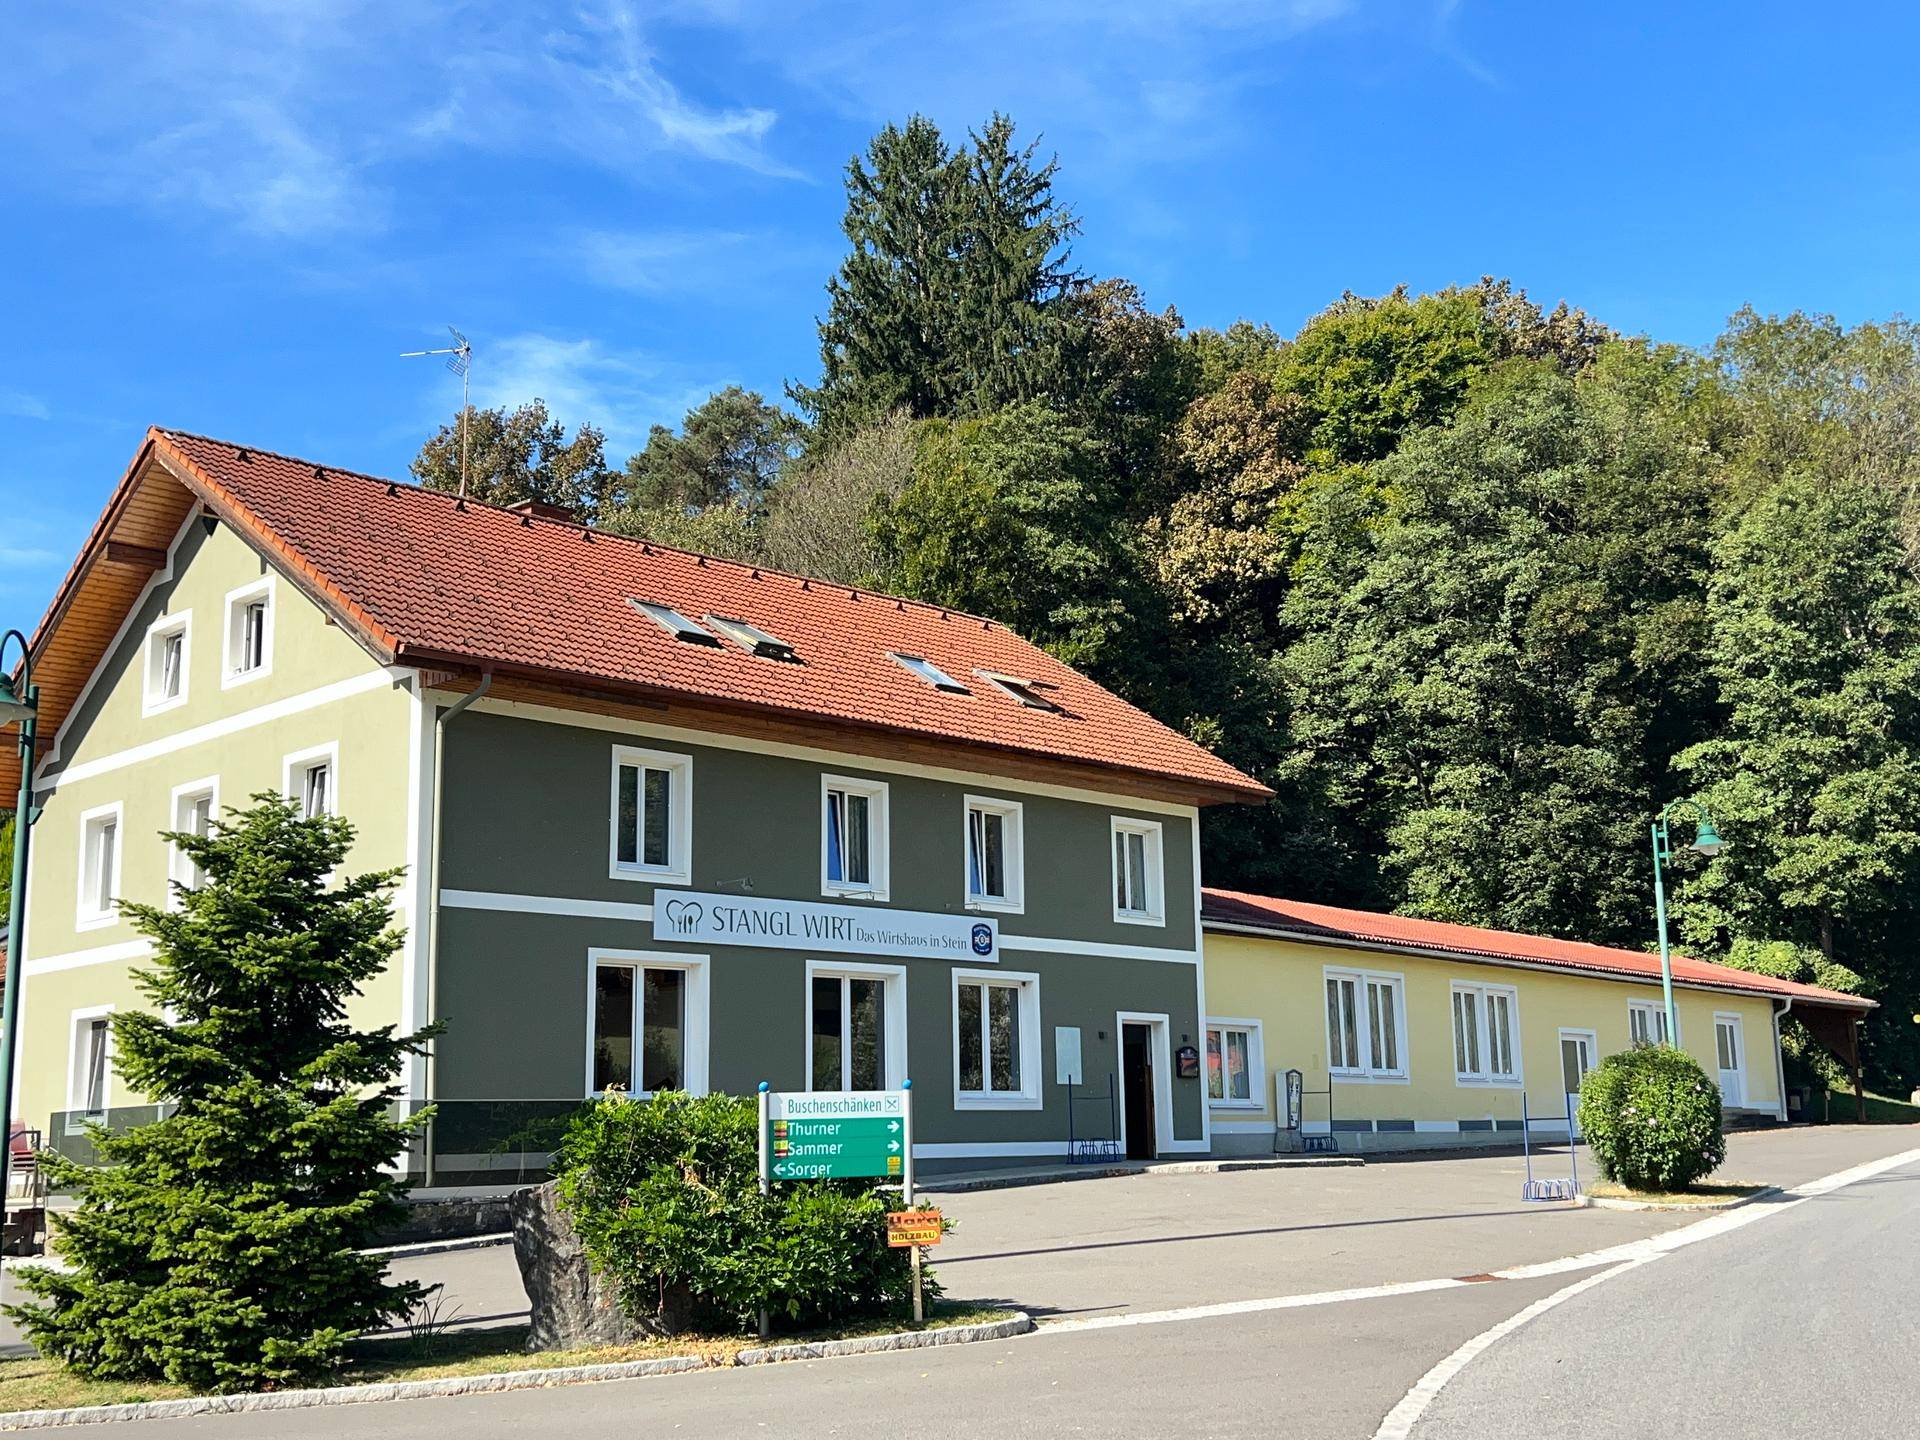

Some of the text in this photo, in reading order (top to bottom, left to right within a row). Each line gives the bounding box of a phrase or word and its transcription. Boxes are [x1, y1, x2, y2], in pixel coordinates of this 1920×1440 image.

[712, 906, 797, 937] STANGL
[802, 914, 855, 941] WIRT
[856, 927, 875, 943] Das
[877, 931, 928, 948] Wirtshaus
[930, 934, 940, 948] in
[941, 935, 967, 950] Stein
[788, 1097, 882, 1114] Buschenschänken
[787, 1122, 841, 1136] Thurner
[788, 1141, 843, 1156] Sammer
[787, 1162, 832, 1178] Sorger
[891, 1232, 935, 1241] HOLZBAU
